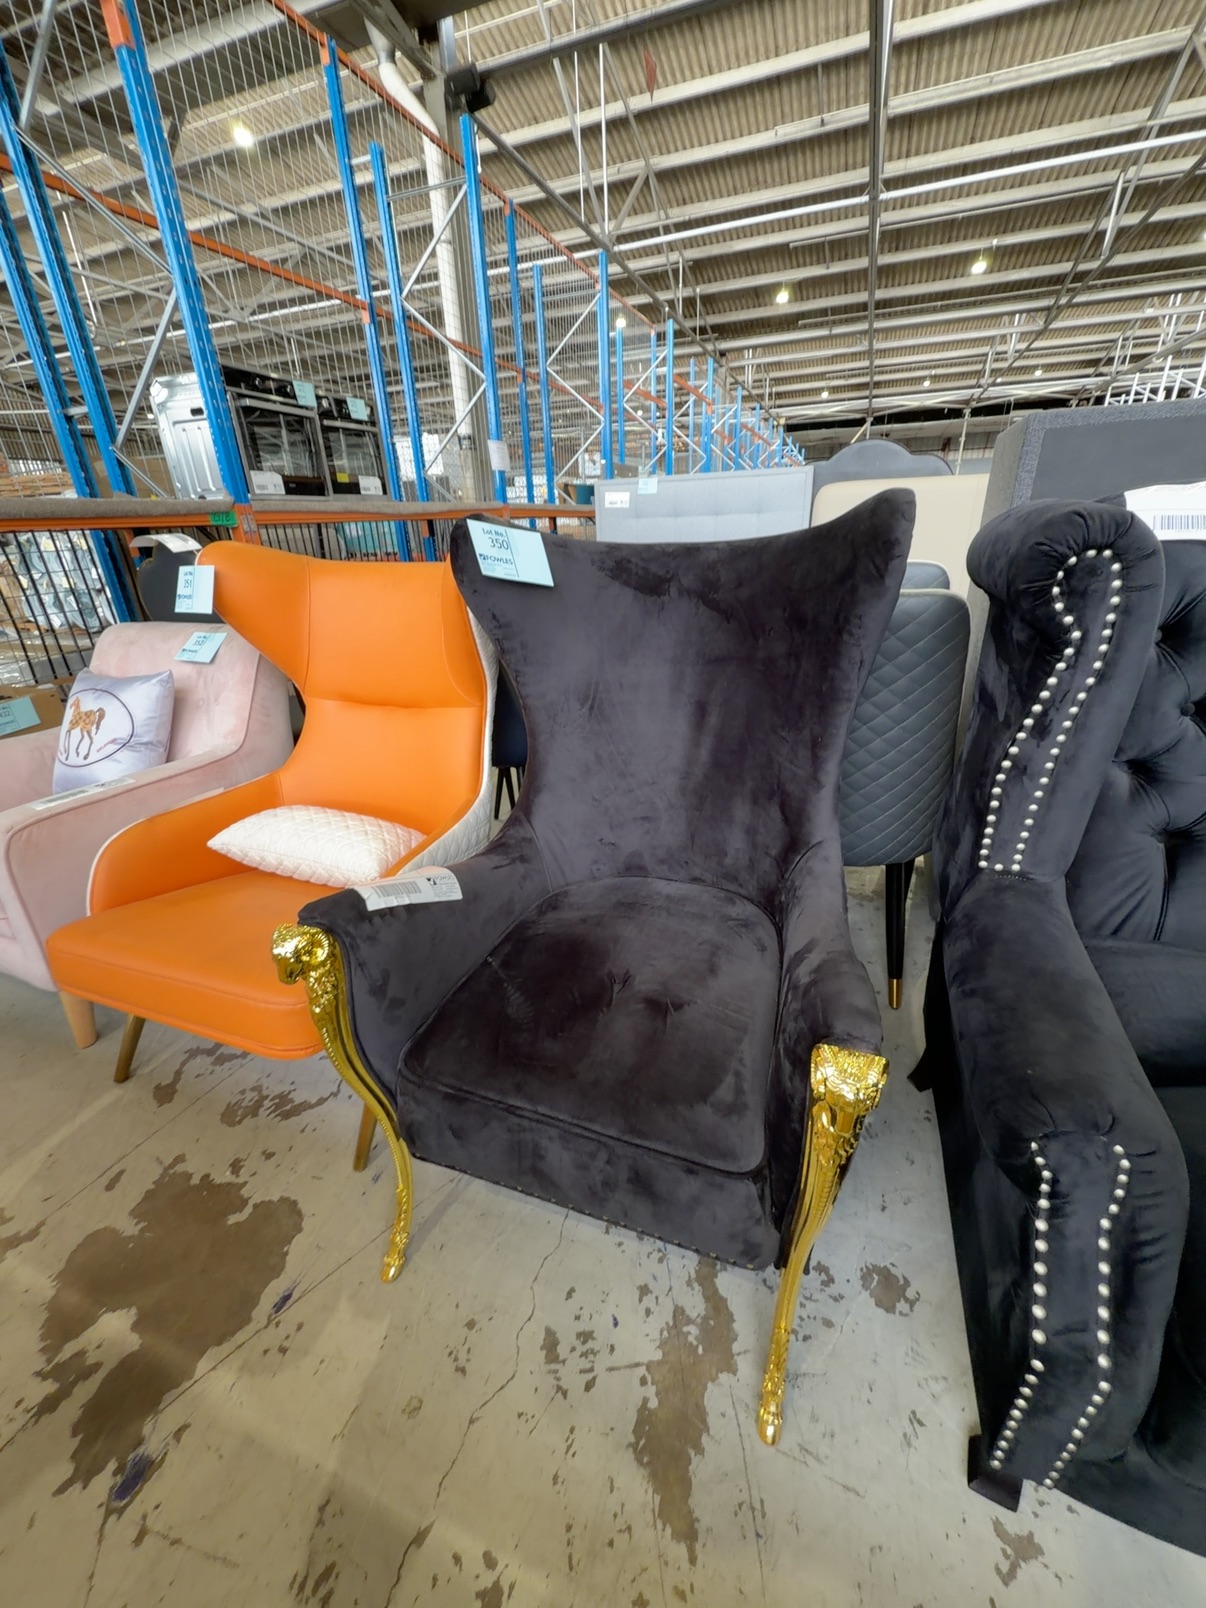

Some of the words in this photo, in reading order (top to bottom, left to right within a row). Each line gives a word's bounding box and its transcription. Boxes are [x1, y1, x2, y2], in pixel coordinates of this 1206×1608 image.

[482, 527, 492, 536] Lot
[493, 529, 506, 538] No.
[488, 537, 510, 550] 350
[183, 579, 192, 589] 351
